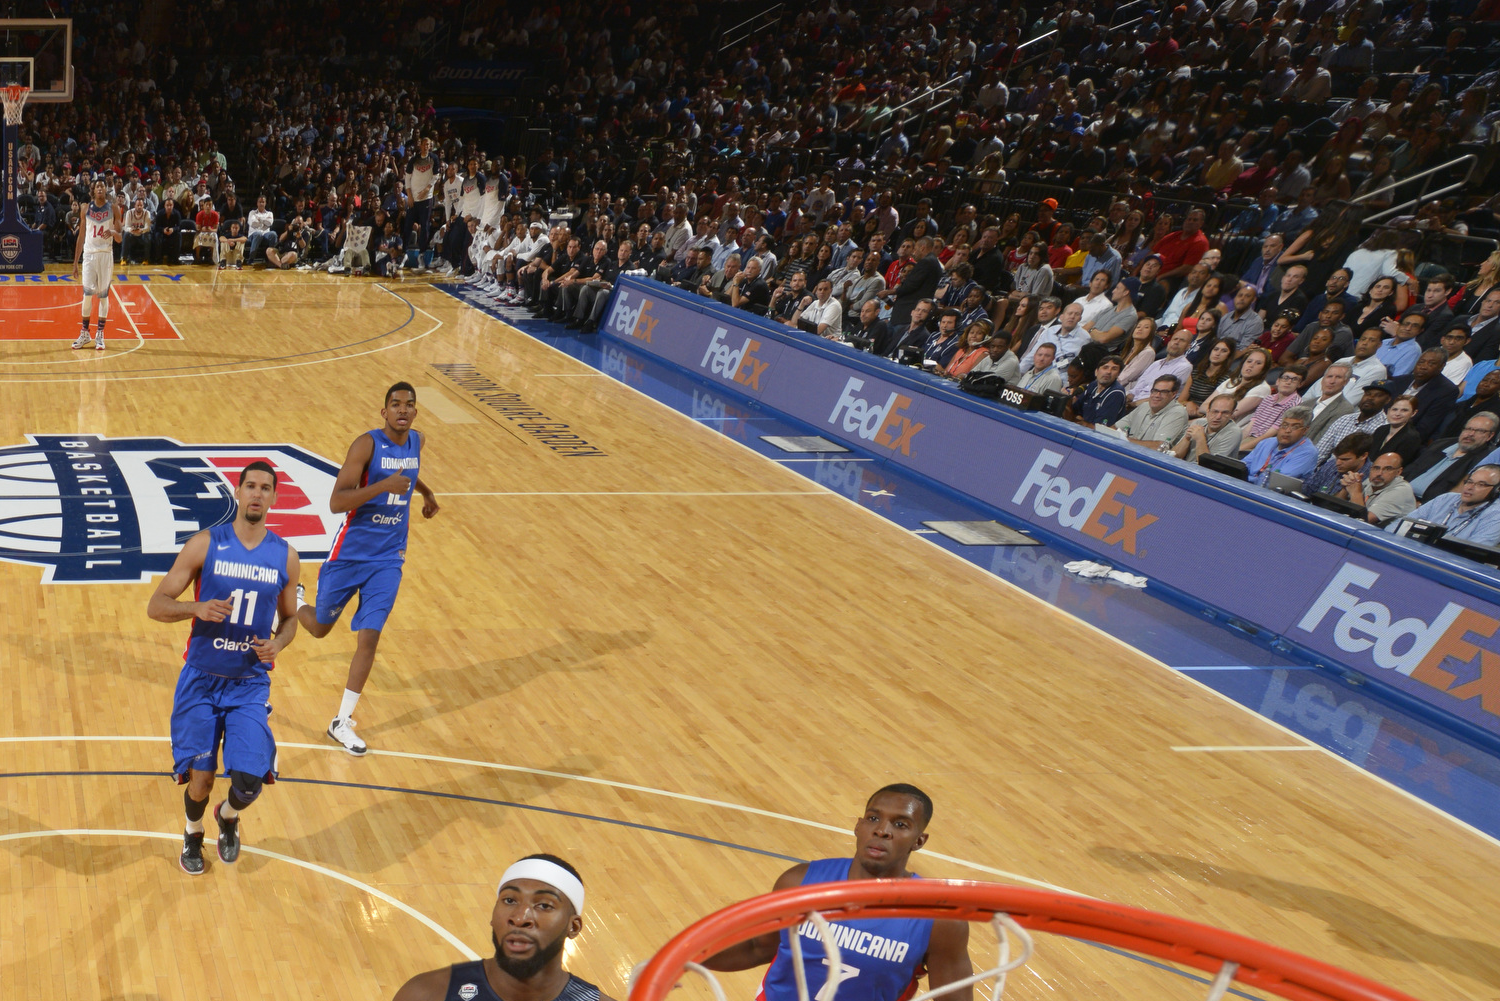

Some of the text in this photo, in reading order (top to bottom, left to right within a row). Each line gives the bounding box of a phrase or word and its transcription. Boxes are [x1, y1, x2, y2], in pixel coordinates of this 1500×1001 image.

[89, 209, 109, 222] USA
[92, 225, 105, 238] 14
[112, 274, 186, 282] ITY
[608, 290, 659, 344] FedEx
[700, 326, 770, 391] FedEx
[1001, 388, 1024, 405] POSS
[473, 393, 551, 420] SQUARE
[517, 423, 609, 457] GARDEN
[827, 376, 925, 457] FedEx
[59, 441, 122, 569] BASKETBALL
[1011, 448, 1160, 556] FedEx
[372, 513, 400, 526] Claro
[213, 559, 279, 585] DOMINICANA
[229, 588, 259, 626] 11
[213, 638, 250, 652] Claro
